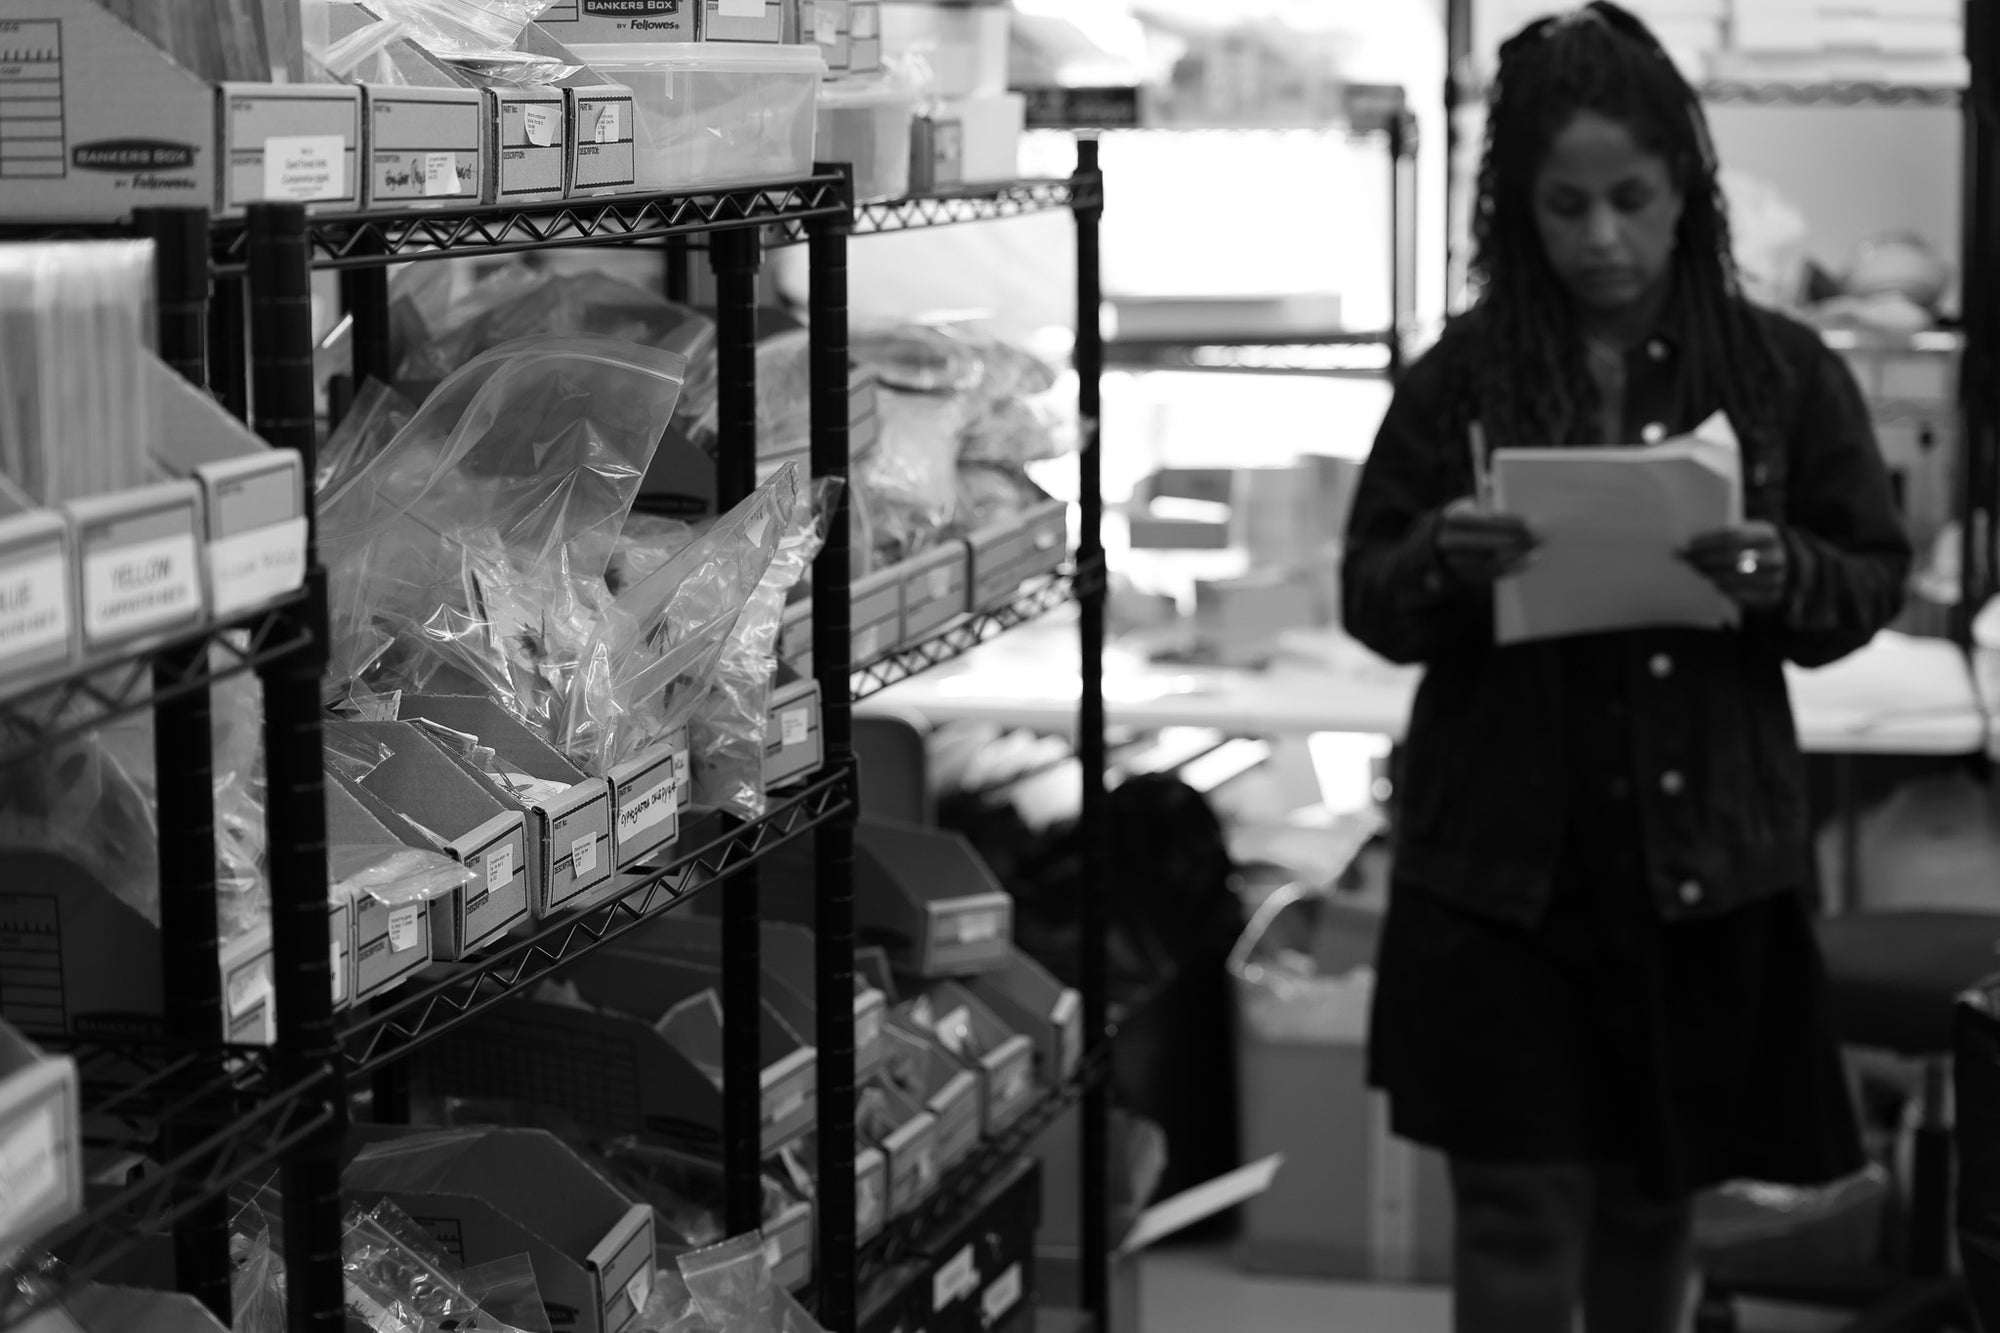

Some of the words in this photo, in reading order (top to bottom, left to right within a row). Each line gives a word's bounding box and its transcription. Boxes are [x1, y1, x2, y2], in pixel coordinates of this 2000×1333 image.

[587, 0, 646, 10] BANKERS
[647, 0, 673, 10] BOX
[76, 149, 150, 164] BANKERS
[153, 148, 185, 164] BOX
[108, 554, 172, 592] YELLOW
[0, 577, 31, 610] LUE
